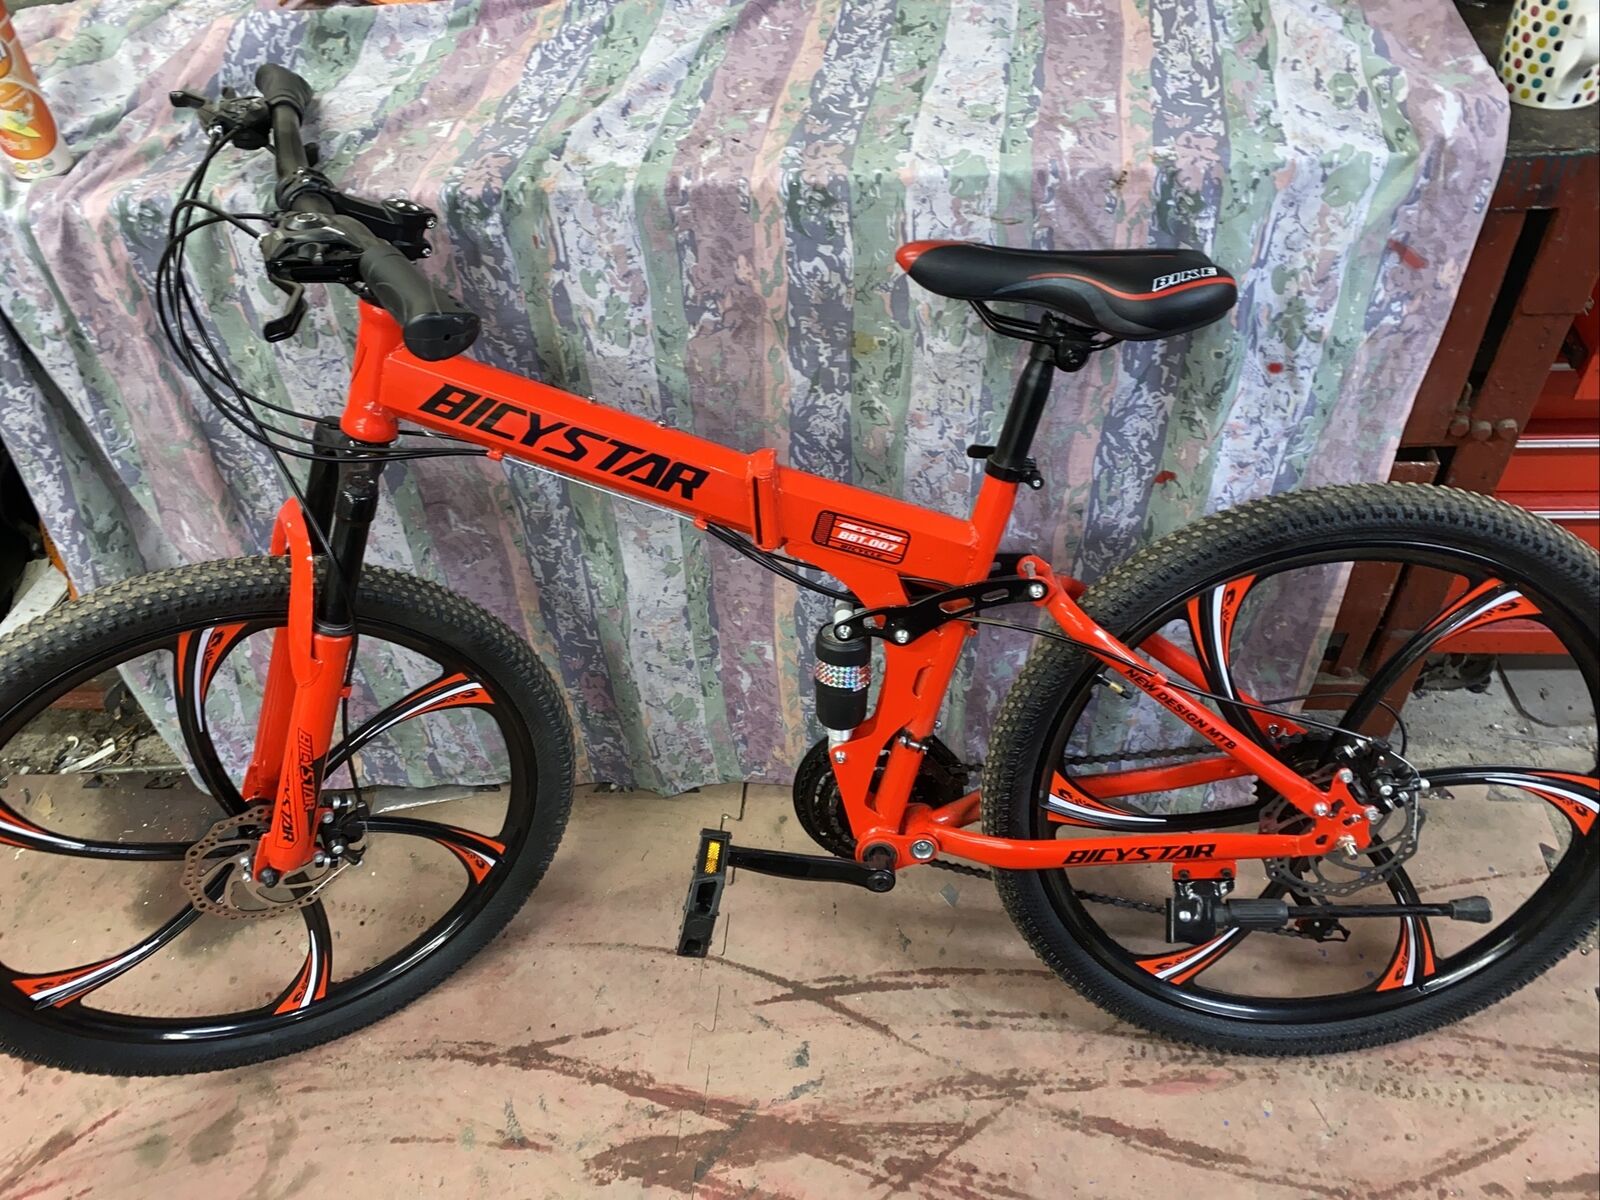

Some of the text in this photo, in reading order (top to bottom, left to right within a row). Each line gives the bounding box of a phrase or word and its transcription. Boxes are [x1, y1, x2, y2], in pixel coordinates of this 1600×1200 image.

[1152, 267, 1218, 292] BIKE
[418, 383, 710, 500] BICYSTAR
[1124, 669, 1237, 750] NEW DESIGN MTB
[298, 727, 317, 813] BICYSTAR
[1062, 843, 1217, 865] BICYSTAR
